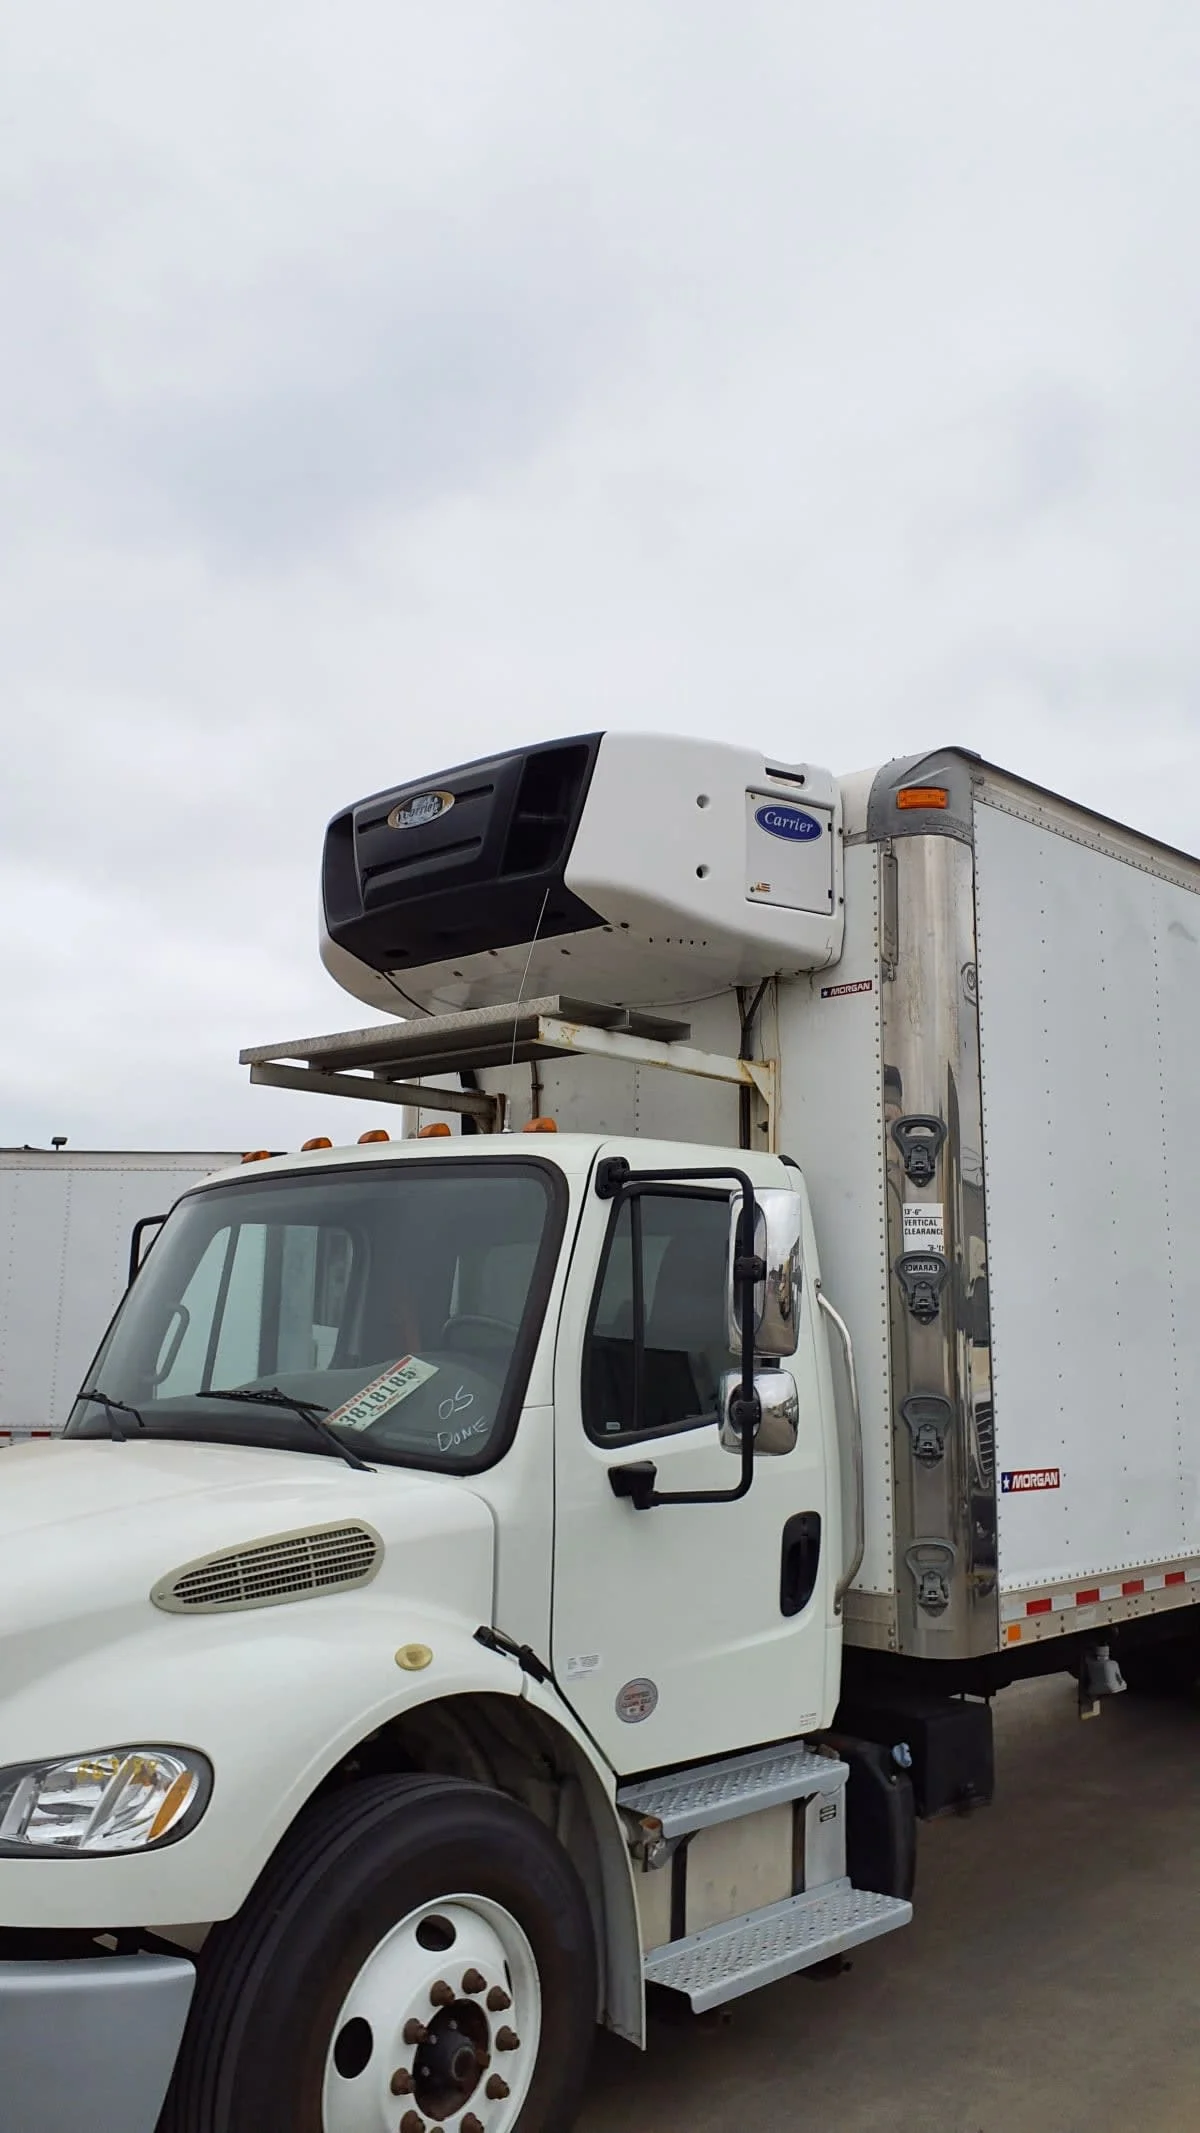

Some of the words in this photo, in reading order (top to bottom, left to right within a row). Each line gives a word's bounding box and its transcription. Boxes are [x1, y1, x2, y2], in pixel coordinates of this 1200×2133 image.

[764, 811, 814, 833] Carrier
[830, 981, 870, 996] MORGAN
[904, 1219, 938, 1227] VERTICAL
[904, 1228, 944, 1236] CLEARANCE
[339, 1368, 417, 1427] 3818185
[1011, 1471, 1059, 1490] MORGAN
